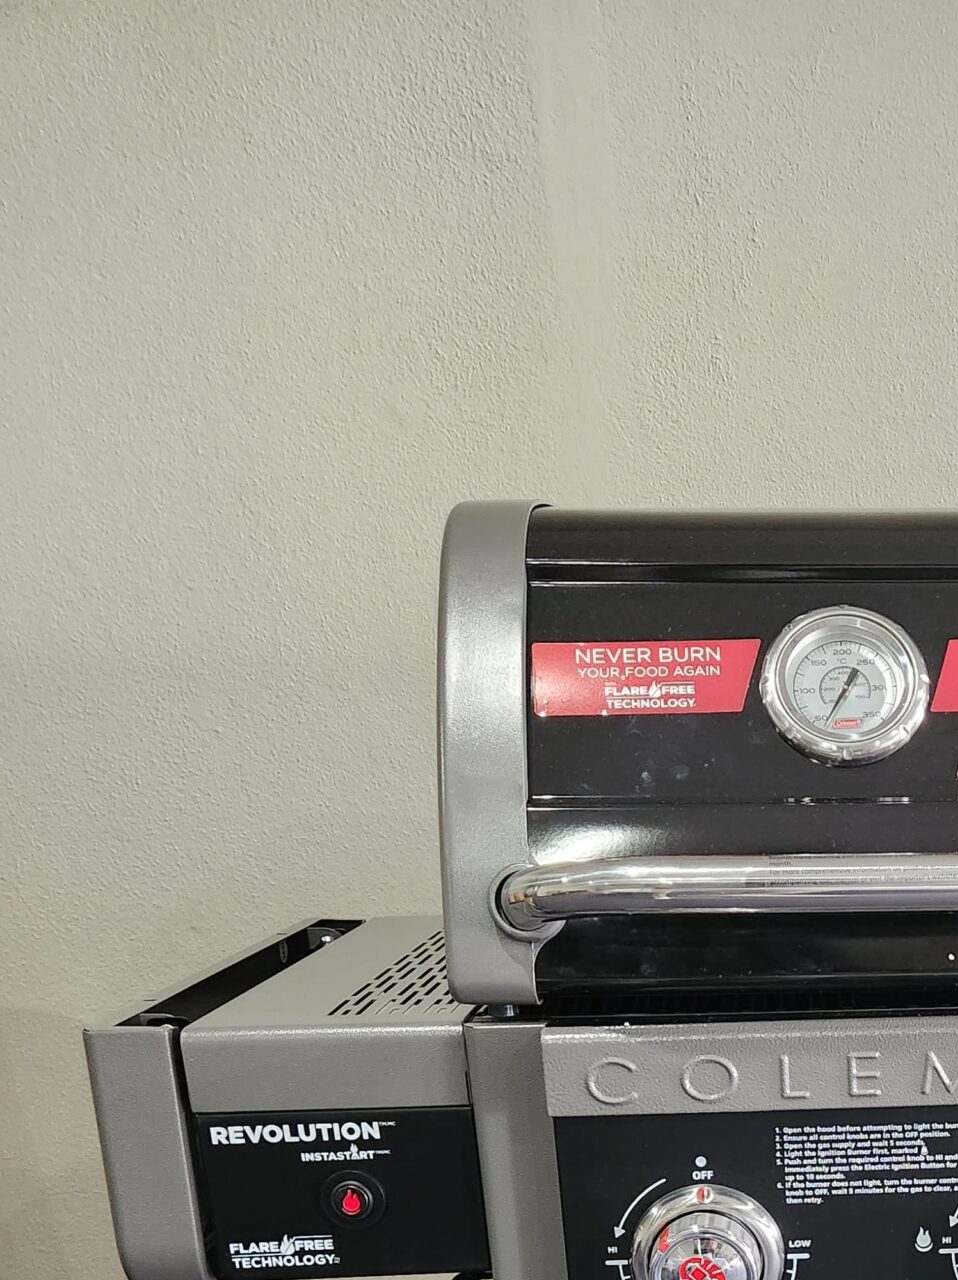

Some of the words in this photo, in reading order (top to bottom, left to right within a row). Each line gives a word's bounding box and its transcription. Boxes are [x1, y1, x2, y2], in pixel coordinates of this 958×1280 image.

[576, 648, 651, 664] NEVER
[659, 647, 720, 662] BURN
[578, 668, 619, 678] YOUR
[625, 666, 668, 677] FOOD
[674, 665, 720, 676] AGAIN
[605, 686, 648, 696] FLARE
[662, 685, 695, 694] FREE
[606, 698, 695, 708] TECHNOLOGY
[210, 1121, 381, 1145] REVOLUTION
[301, 1150, 374, 1162] INSTASTART
[692, 1171, 713, 1180] OFF
[229, 1241, 279, 1254] FLARE
[295, 1239, 334, 1251] FREE
[789, 1240, 811, 1248] LOW
[232, 1254, 335, 1268] TECHNOLOGY
